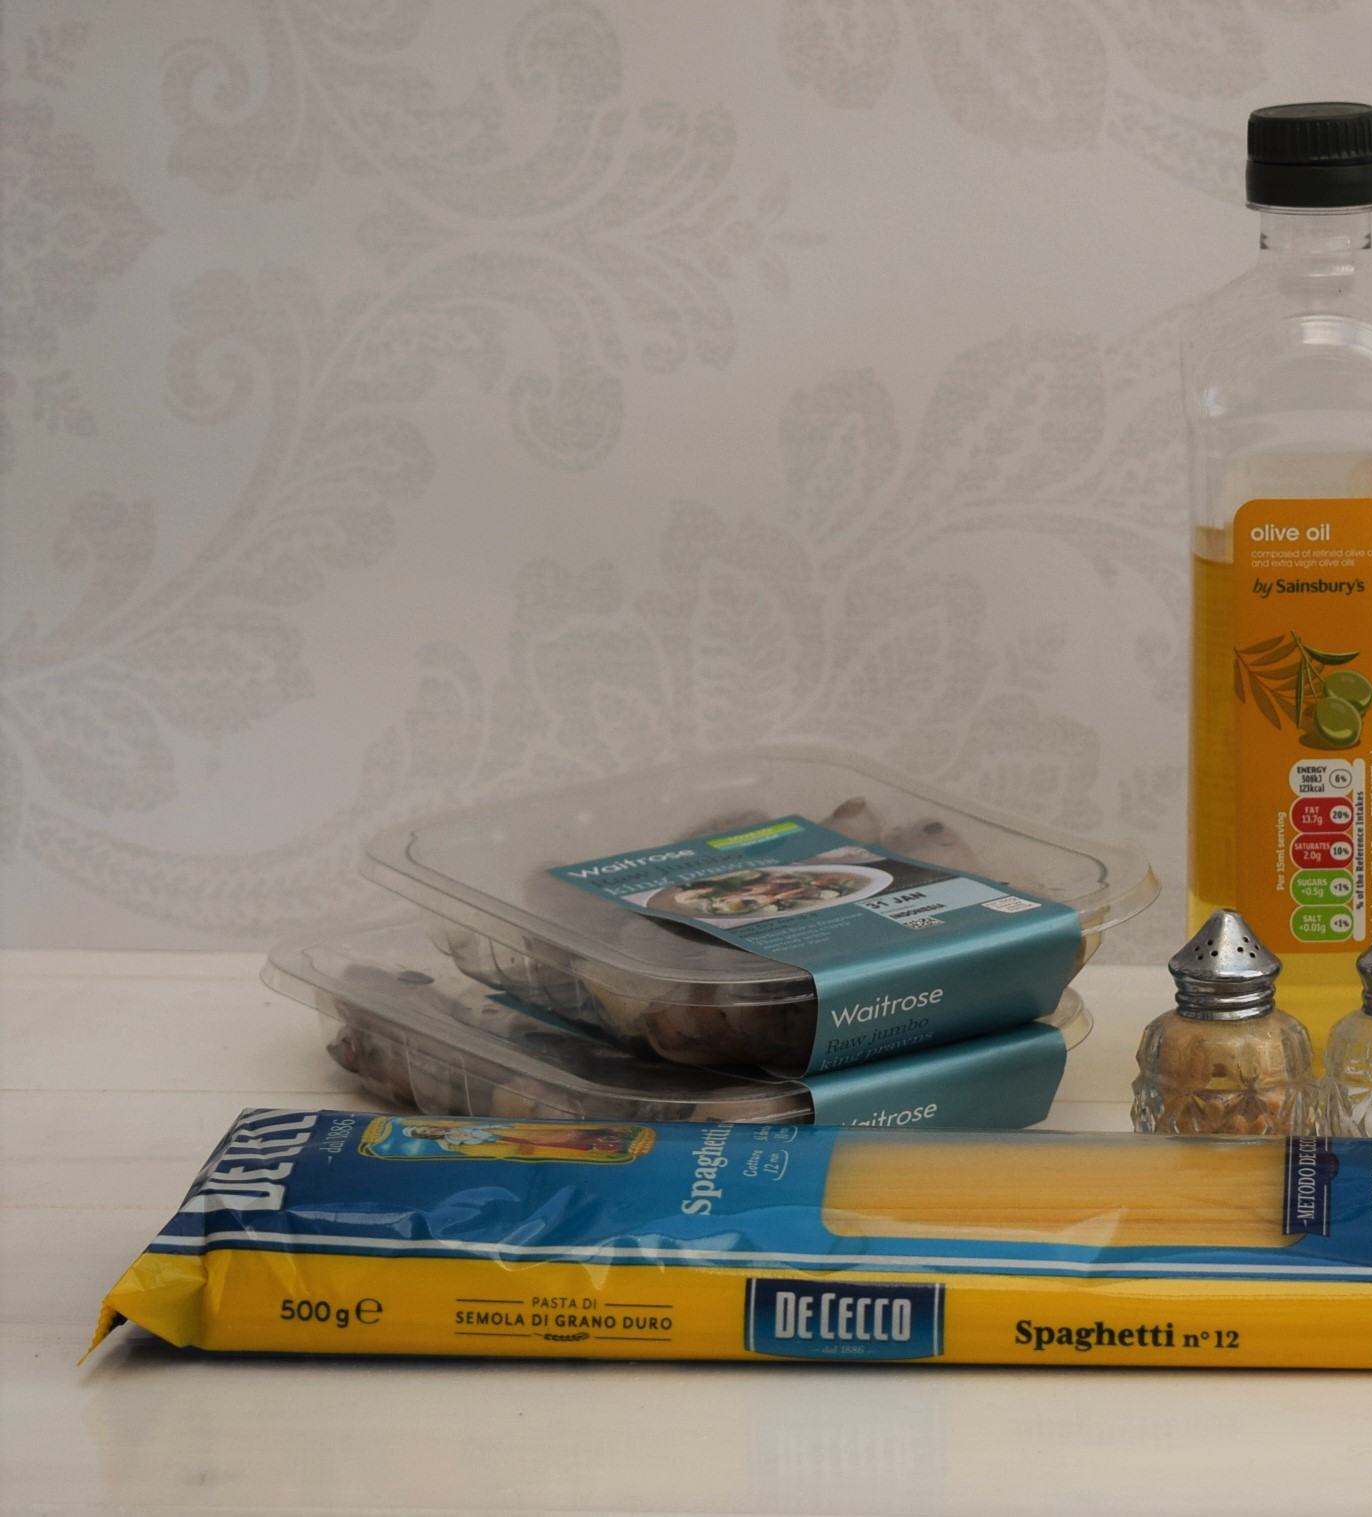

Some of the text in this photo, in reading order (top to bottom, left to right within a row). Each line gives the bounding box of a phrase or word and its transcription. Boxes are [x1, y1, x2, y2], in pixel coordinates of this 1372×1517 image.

[1250, 523, 1330, 541] olive oil
[1250, 549, 1300, 560] composed
[1302, 549, 1311, 558] of
[1312, 549, 1343, 558] refined
[1345, 548, 1366, 558] olive
[1251, 558, 1355, 568] and extra virgin olive oils
[1252, 578, 1365, 599] by Sainsbury's
[1296, 766, 1327, 774] ENERGY
[1335, 774, 1347, 783] 6%
[1304, 806, 1320, 814] FAT
[1332, 810, 1349, 819] 20%
[1355, 792, 1364, 824] Intakes
[1302, 815, 1323, 826] 13.7g
[1276, 812, 1287, 850] serving
[1294, 842, 1350, 856] SATURATES 10%
[1355, 828, 1364, 872] Reference
[567, 849, 695, 878] Waitrose
[1303, 851, 1322, 862] 2.0g
[1276, 875, 1285, 890] Per
[1296, 878, 1328, 886] SUGARS
[1355, 874, 1364, 888] the
[892, 890, 927, 904] JAN
[1355, 890, 1364, 899] of
[1302, 914, 1322, 922] SALT
[831, 988, 944, 1029] Waitrose
[824, 1018, 929, 1056] Raw jumbo
[325, 1118, 356, 1141] 1886
[1299, 1154, 1317, 1166] DE
[680, 1129, 732, 1216] Spaghetti
[1297, 1168, 1316, 1220] METODO
[532, 1296, 597, 1310] PASTA DI
[456, 1311, 673, 1330] SEMOLA DI GRANO DURO
[774, 1291, 912, 1341] DE CECCO
[1015, 1320, 1175, 1352] Spaghetti
